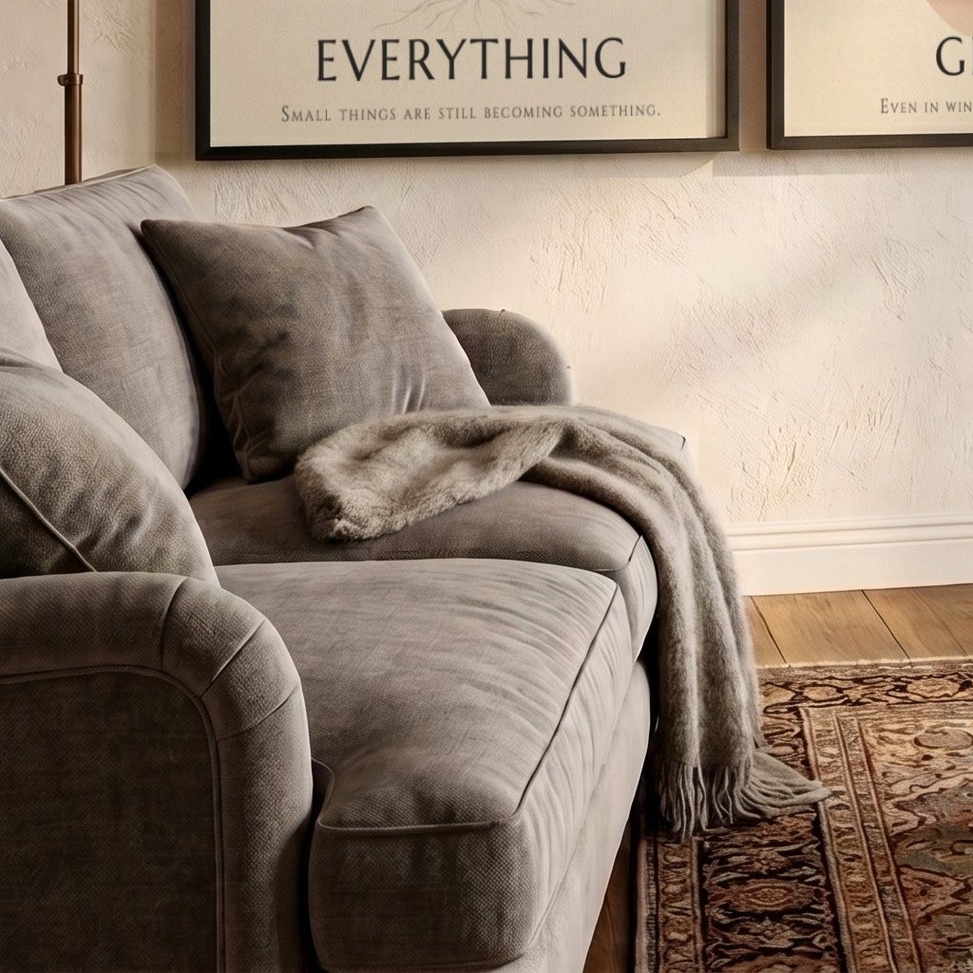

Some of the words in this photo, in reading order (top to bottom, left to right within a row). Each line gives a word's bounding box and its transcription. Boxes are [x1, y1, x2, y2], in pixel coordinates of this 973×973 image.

[317, 36, 627, 83] EVERYTHING
[338, 107, 396, 122] THINGS
[403, 107, 431, 121] ARE
[438, 106, 477, 120] STILL
[483, 105, 563, 119] BECOMING
[924, 101, 939, 114] IN
